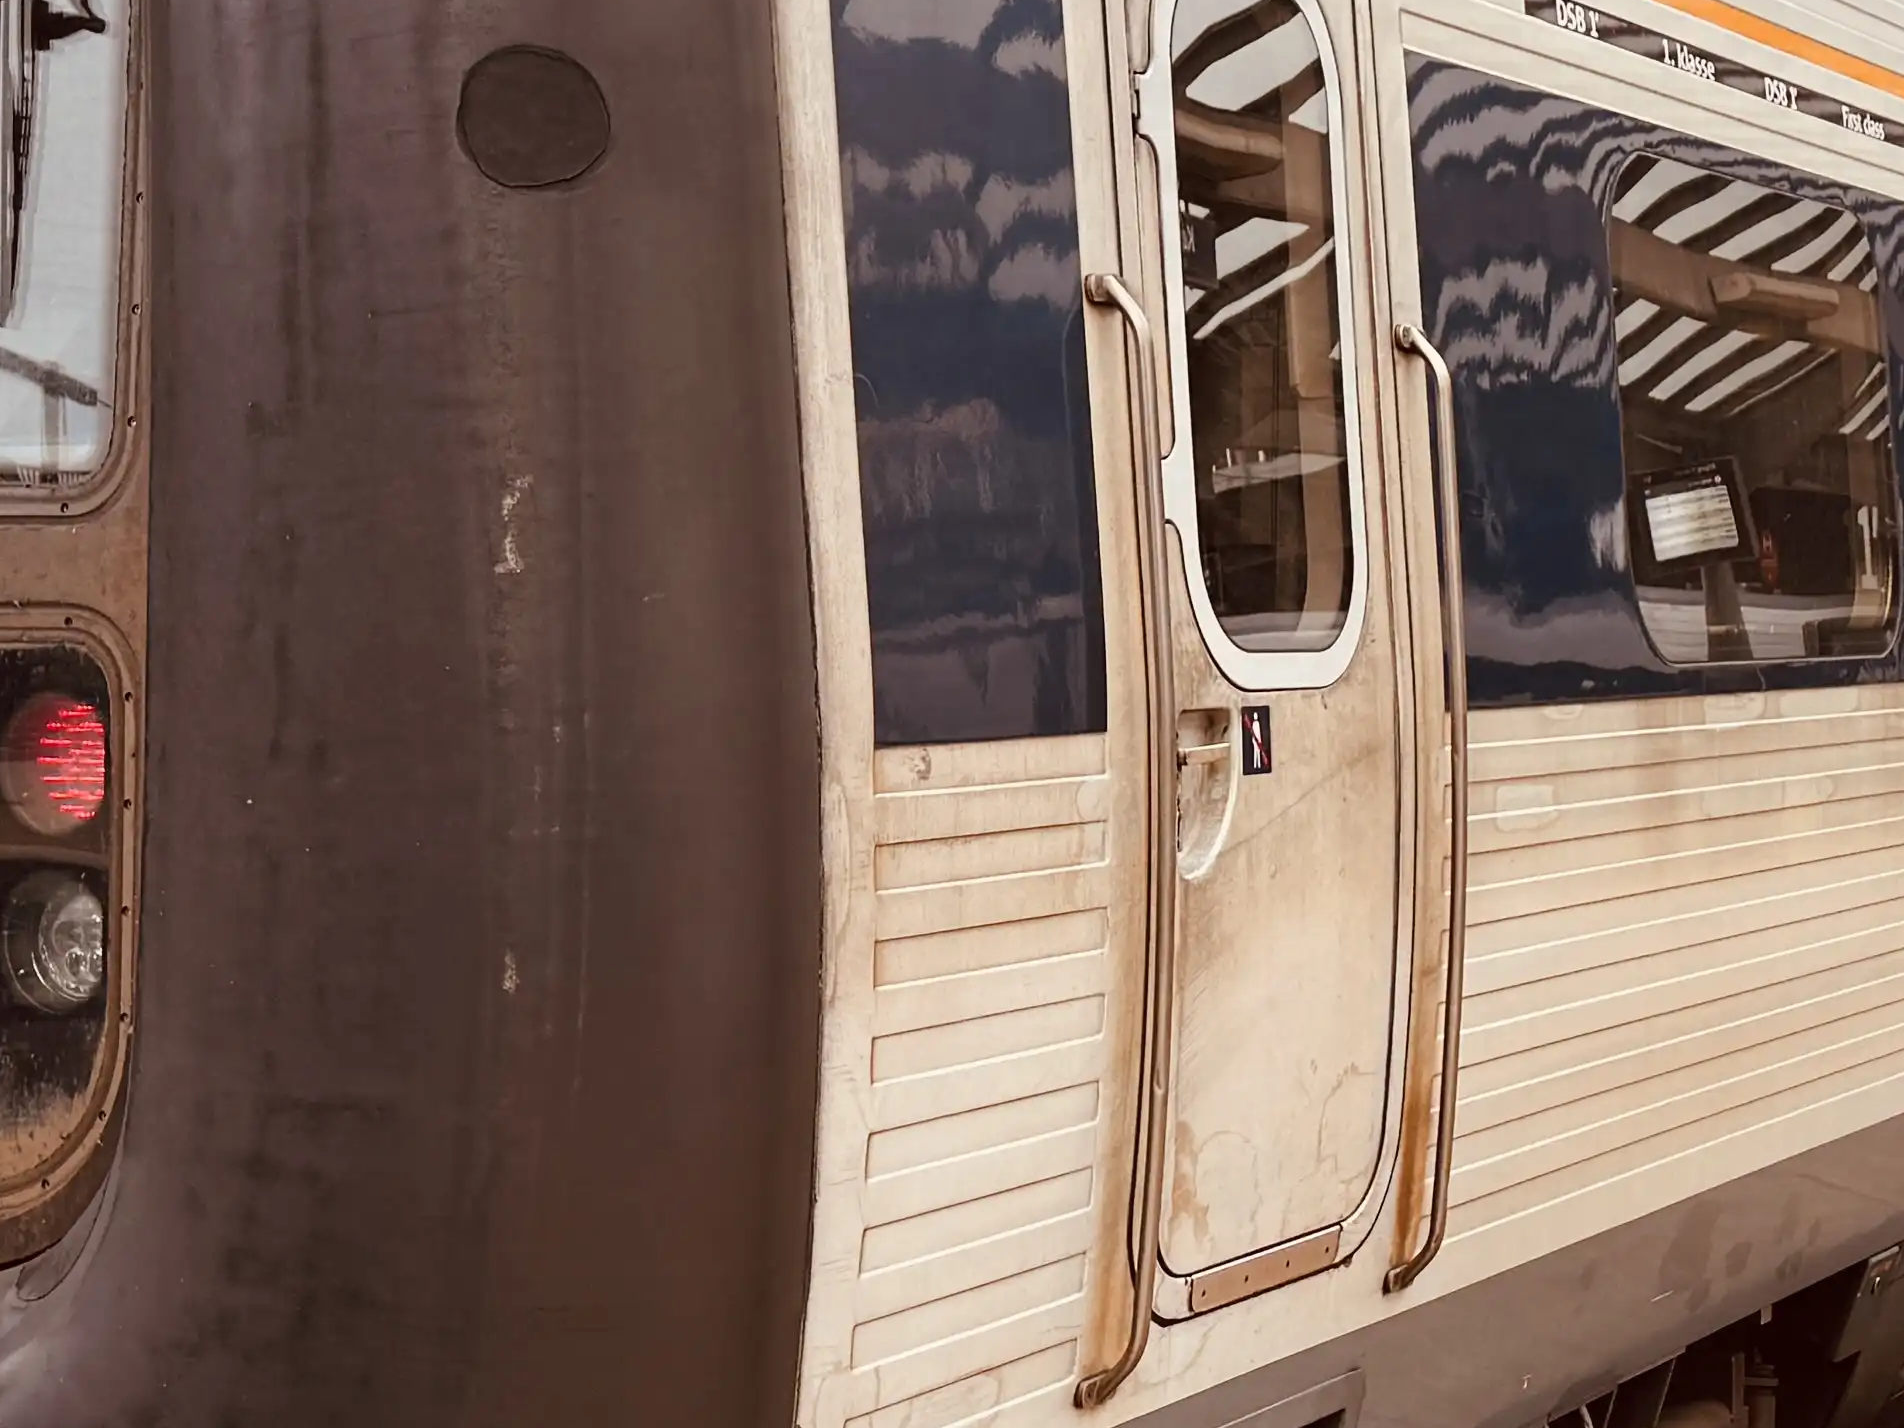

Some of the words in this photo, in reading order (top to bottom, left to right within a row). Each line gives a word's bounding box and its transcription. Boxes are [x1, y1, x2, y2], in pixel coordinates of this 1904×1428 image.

[1676, 42, 1716, 82] klasse
[1764, 76, 1788, 107] DSB
[1841, 104, 1863, 133] First
[1863, 113, 1885, 140] class
